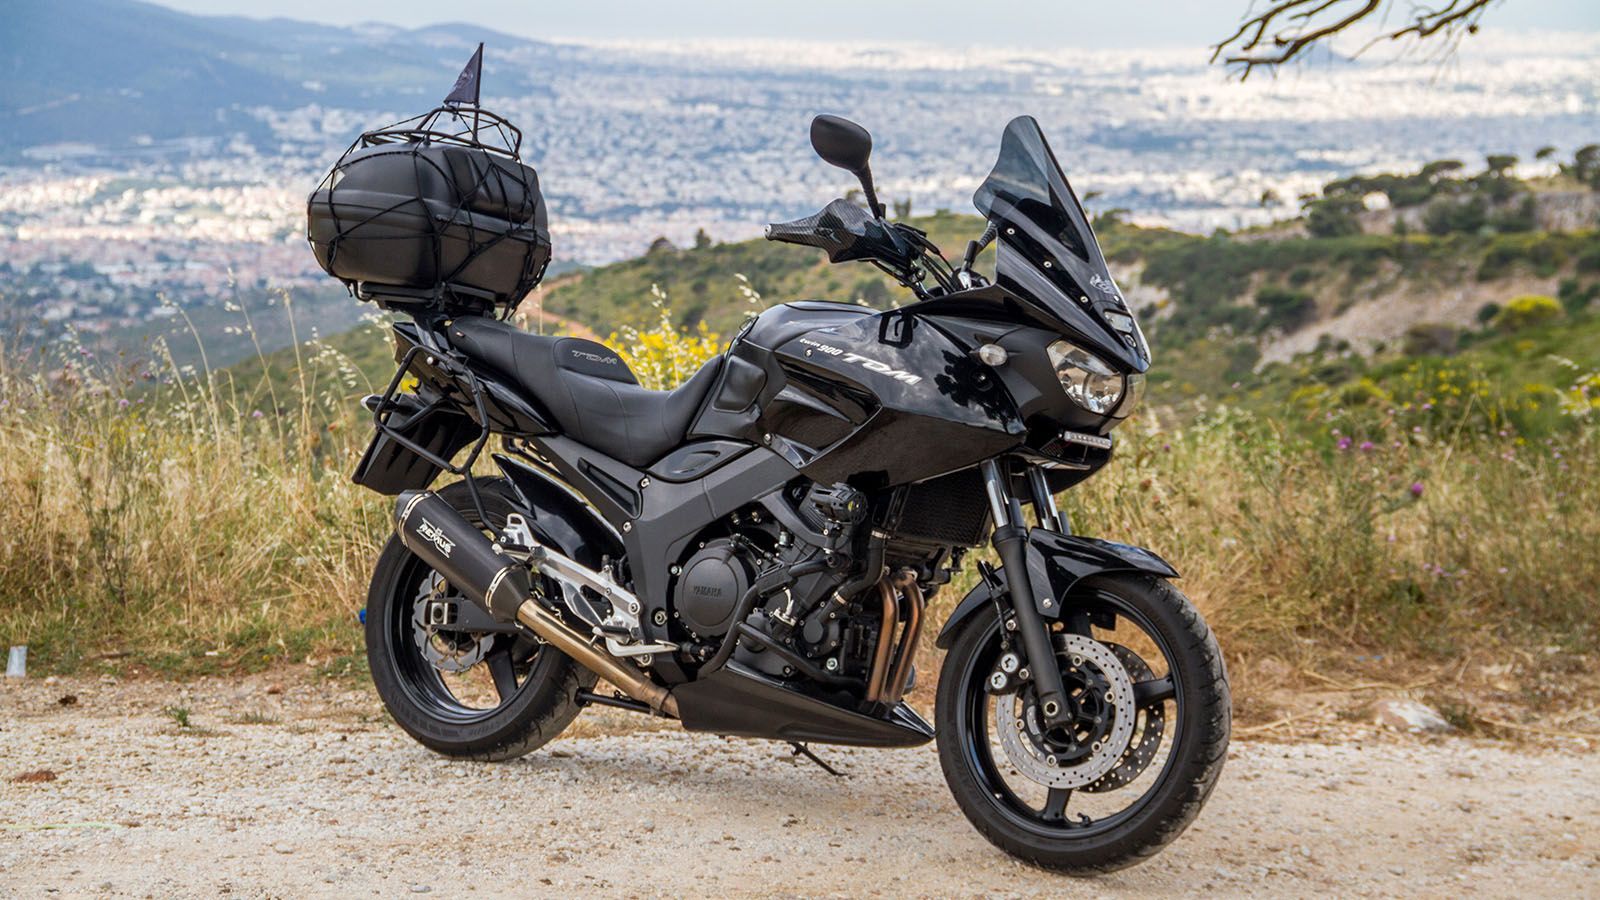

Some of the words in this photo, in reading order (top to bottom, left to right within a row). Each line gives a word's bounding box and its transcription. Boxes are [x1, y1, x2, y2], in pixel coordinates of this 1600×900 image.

[571, 349, 618, 365] TDM
[817, 344, 844, 356] 900
[842, 352, 922, 385] TDM
[418, 521, 452, 554] REMUS
